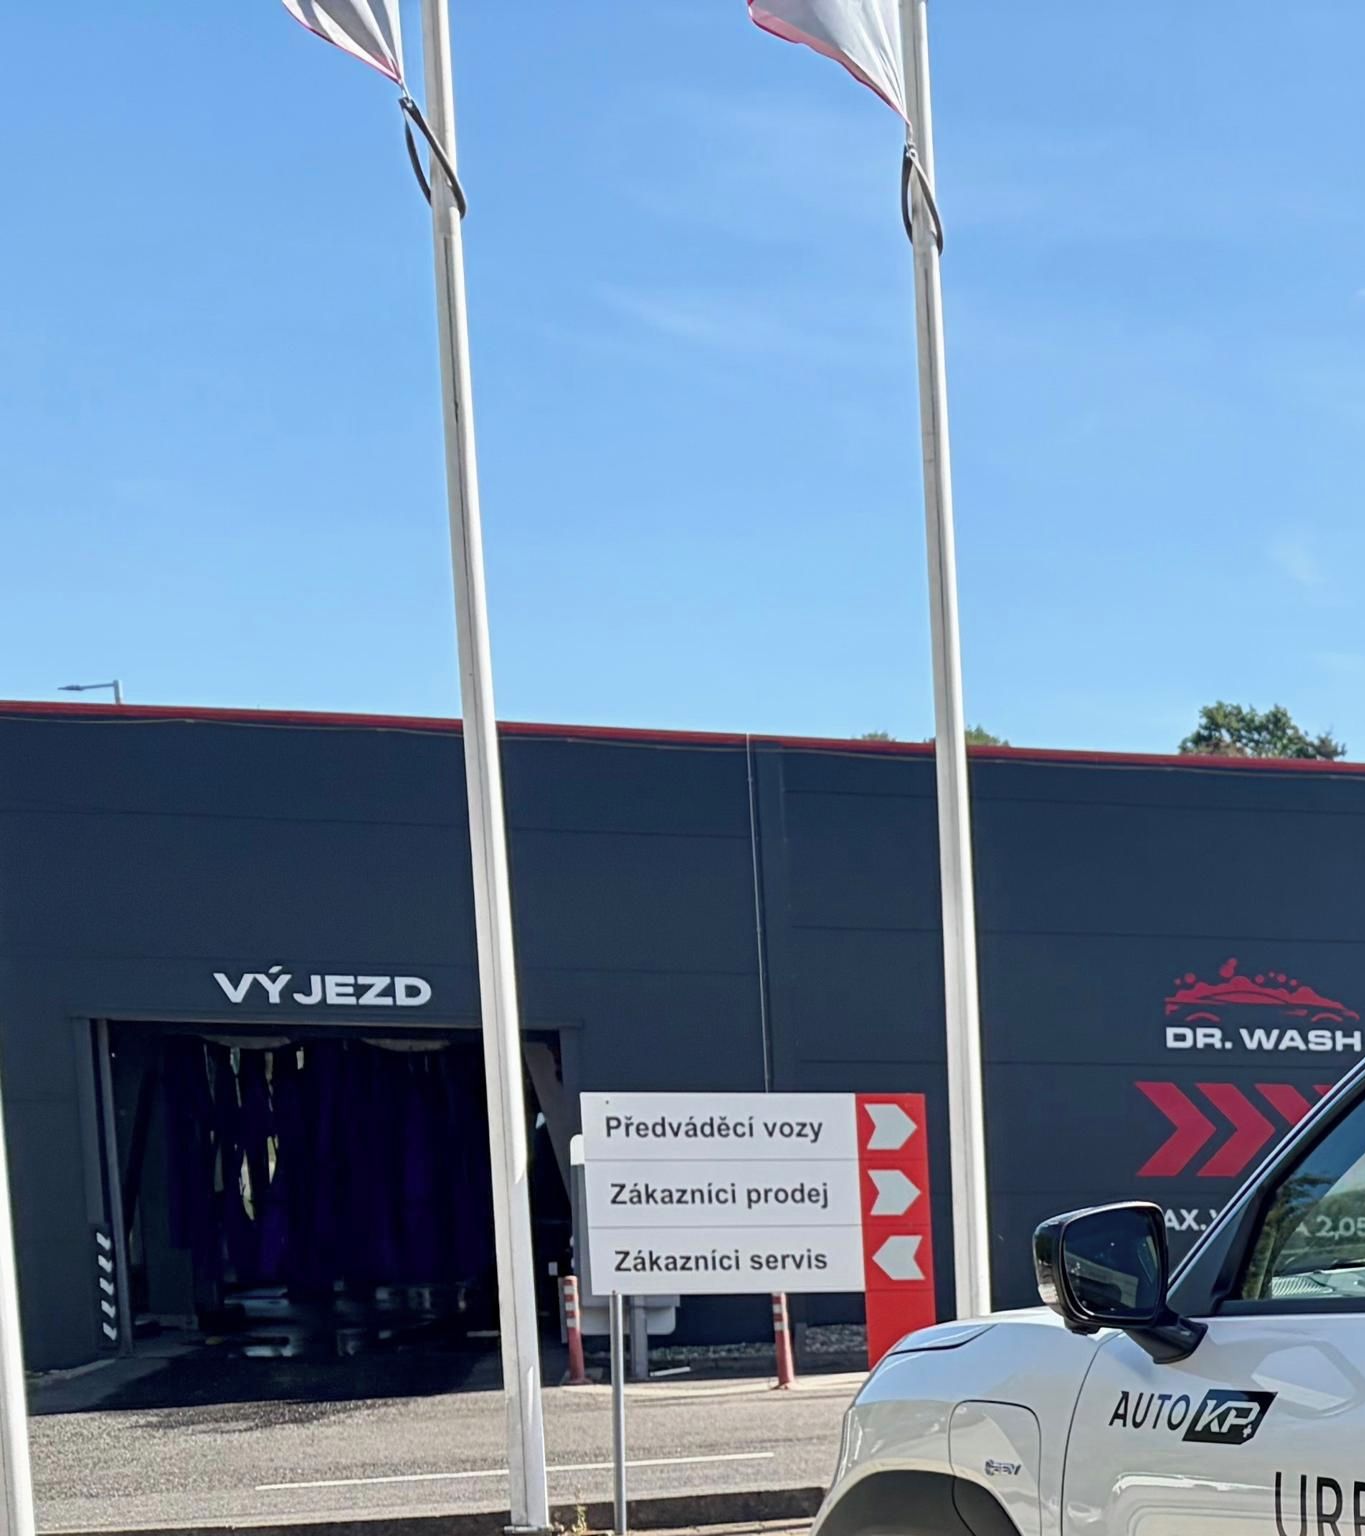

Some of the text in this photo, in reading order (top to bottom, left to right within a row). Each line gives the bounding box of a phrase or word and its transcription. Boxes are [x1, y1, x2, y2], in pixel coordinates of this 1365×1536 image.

[212, 965, 433, 1007] VÝJEZD
[1165, 1026, 1362, 1052] DR. WASH
[604, 1115, 823, 1143] Předváděcí vozy
[609, 1181, 829, 1210] Zákazníci prodej
[1163, 1208, 1208, 1232] AX.
[613, 1247, 829, 1273] Zákazníci servis
[1108, 1390, 1191, 1431] AUTO
